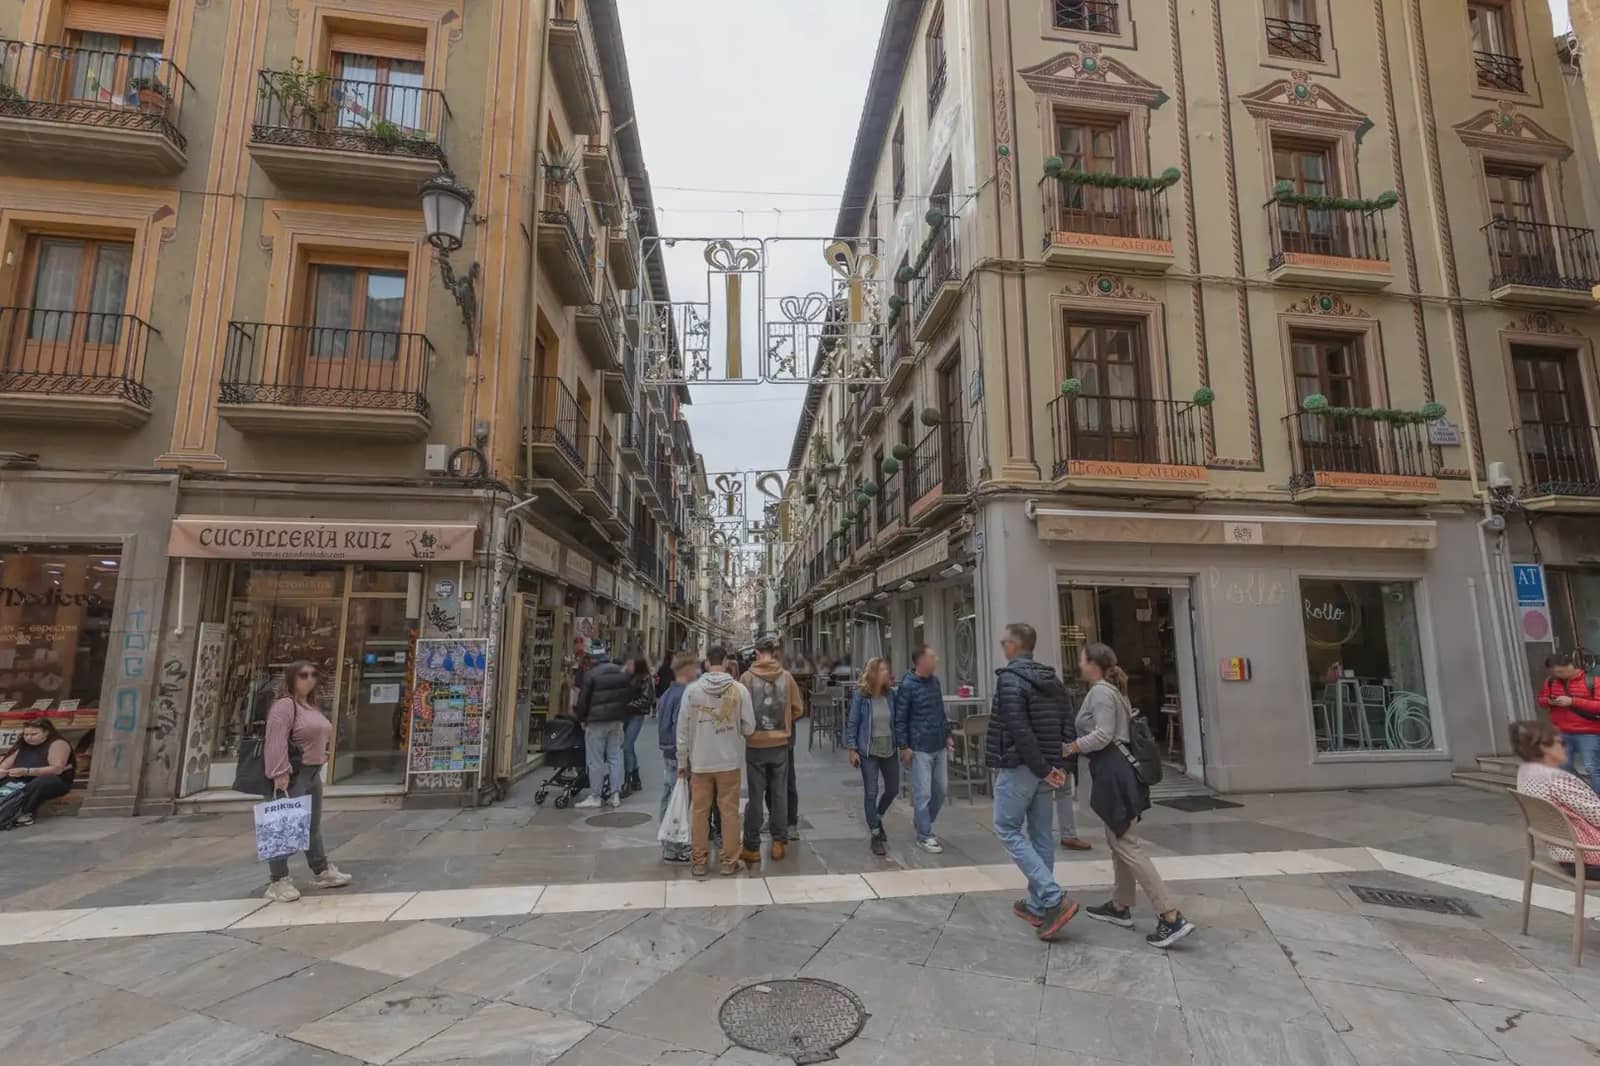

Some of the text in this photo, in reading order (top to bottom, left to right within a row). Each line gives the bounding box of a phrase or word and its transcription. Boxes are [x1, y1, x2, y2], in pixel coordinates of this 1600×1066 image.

[1085, 465, 1201, 480] CASA CATEDRAL
[344, 530, 392, 549] RUIZ
[1518, 568, 1537, 585] AT
[1303, 599, 1345, 621] Rollo
